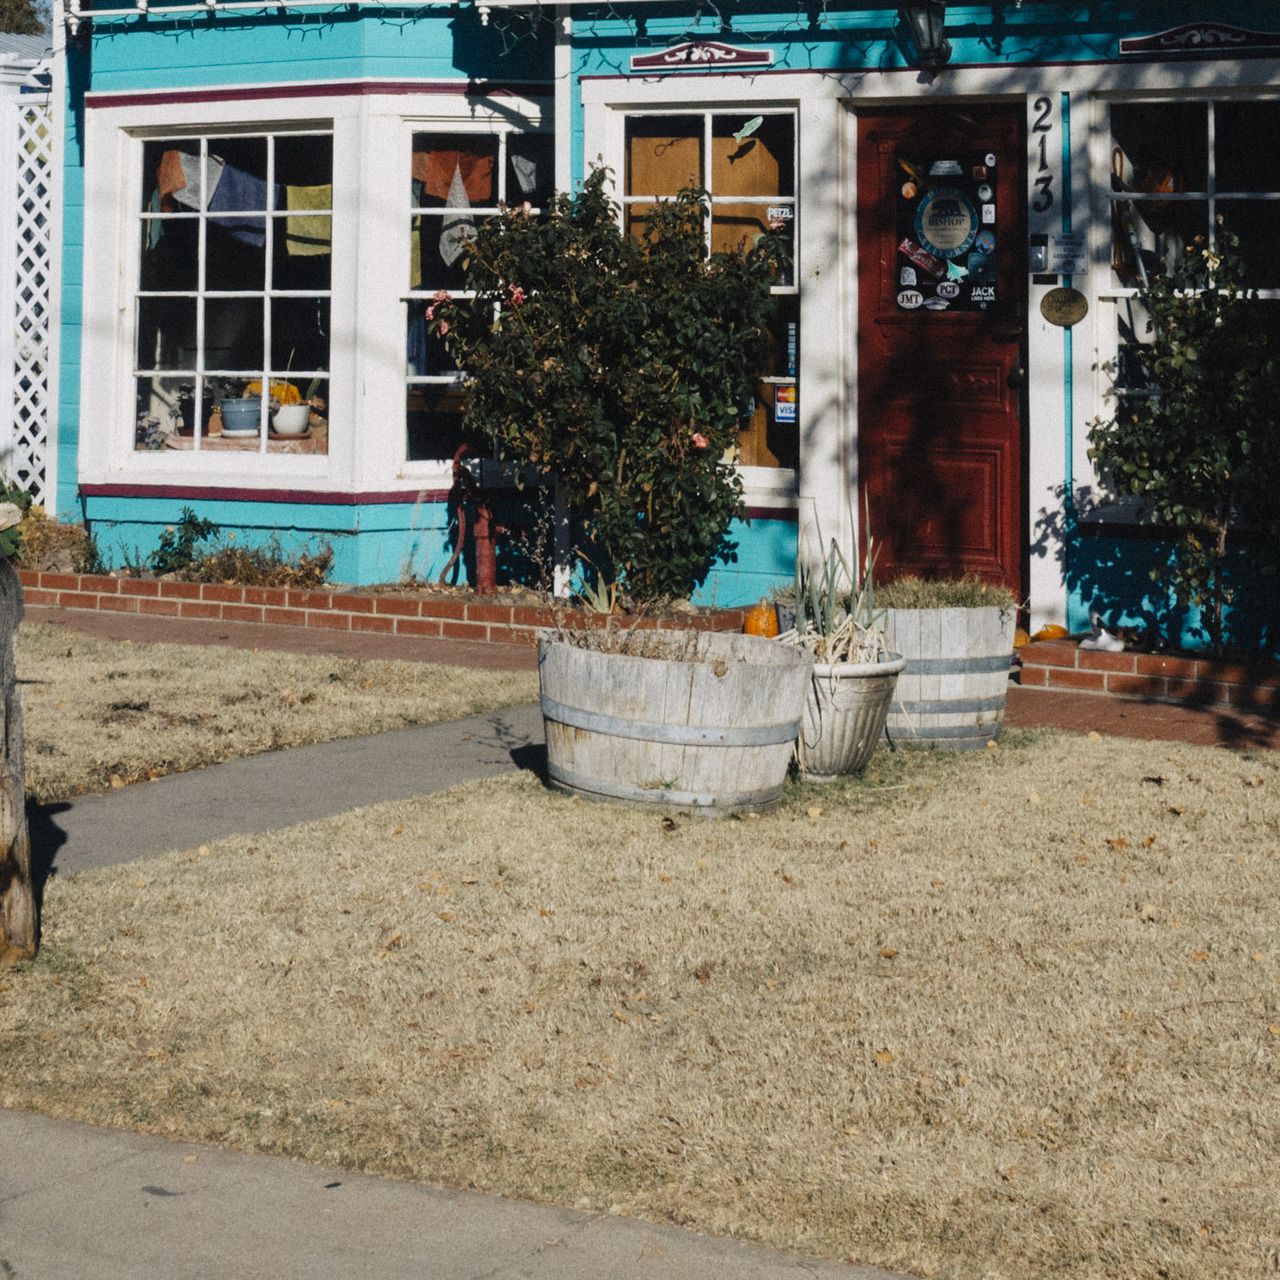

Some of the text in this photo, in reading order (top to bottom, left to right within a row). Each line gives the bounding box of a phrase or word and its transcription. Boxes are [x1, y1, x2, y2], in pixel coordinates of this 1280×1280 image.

[1032, 96, 1053, 213] 213
[768, 207, 793, 218] PETZL
[928, 216, 965, 226] BISHOP
[940, 285, 956, 294] PCT
[971, 286, 995, 296] JACK
[900, 294, 919, 304] JMT
